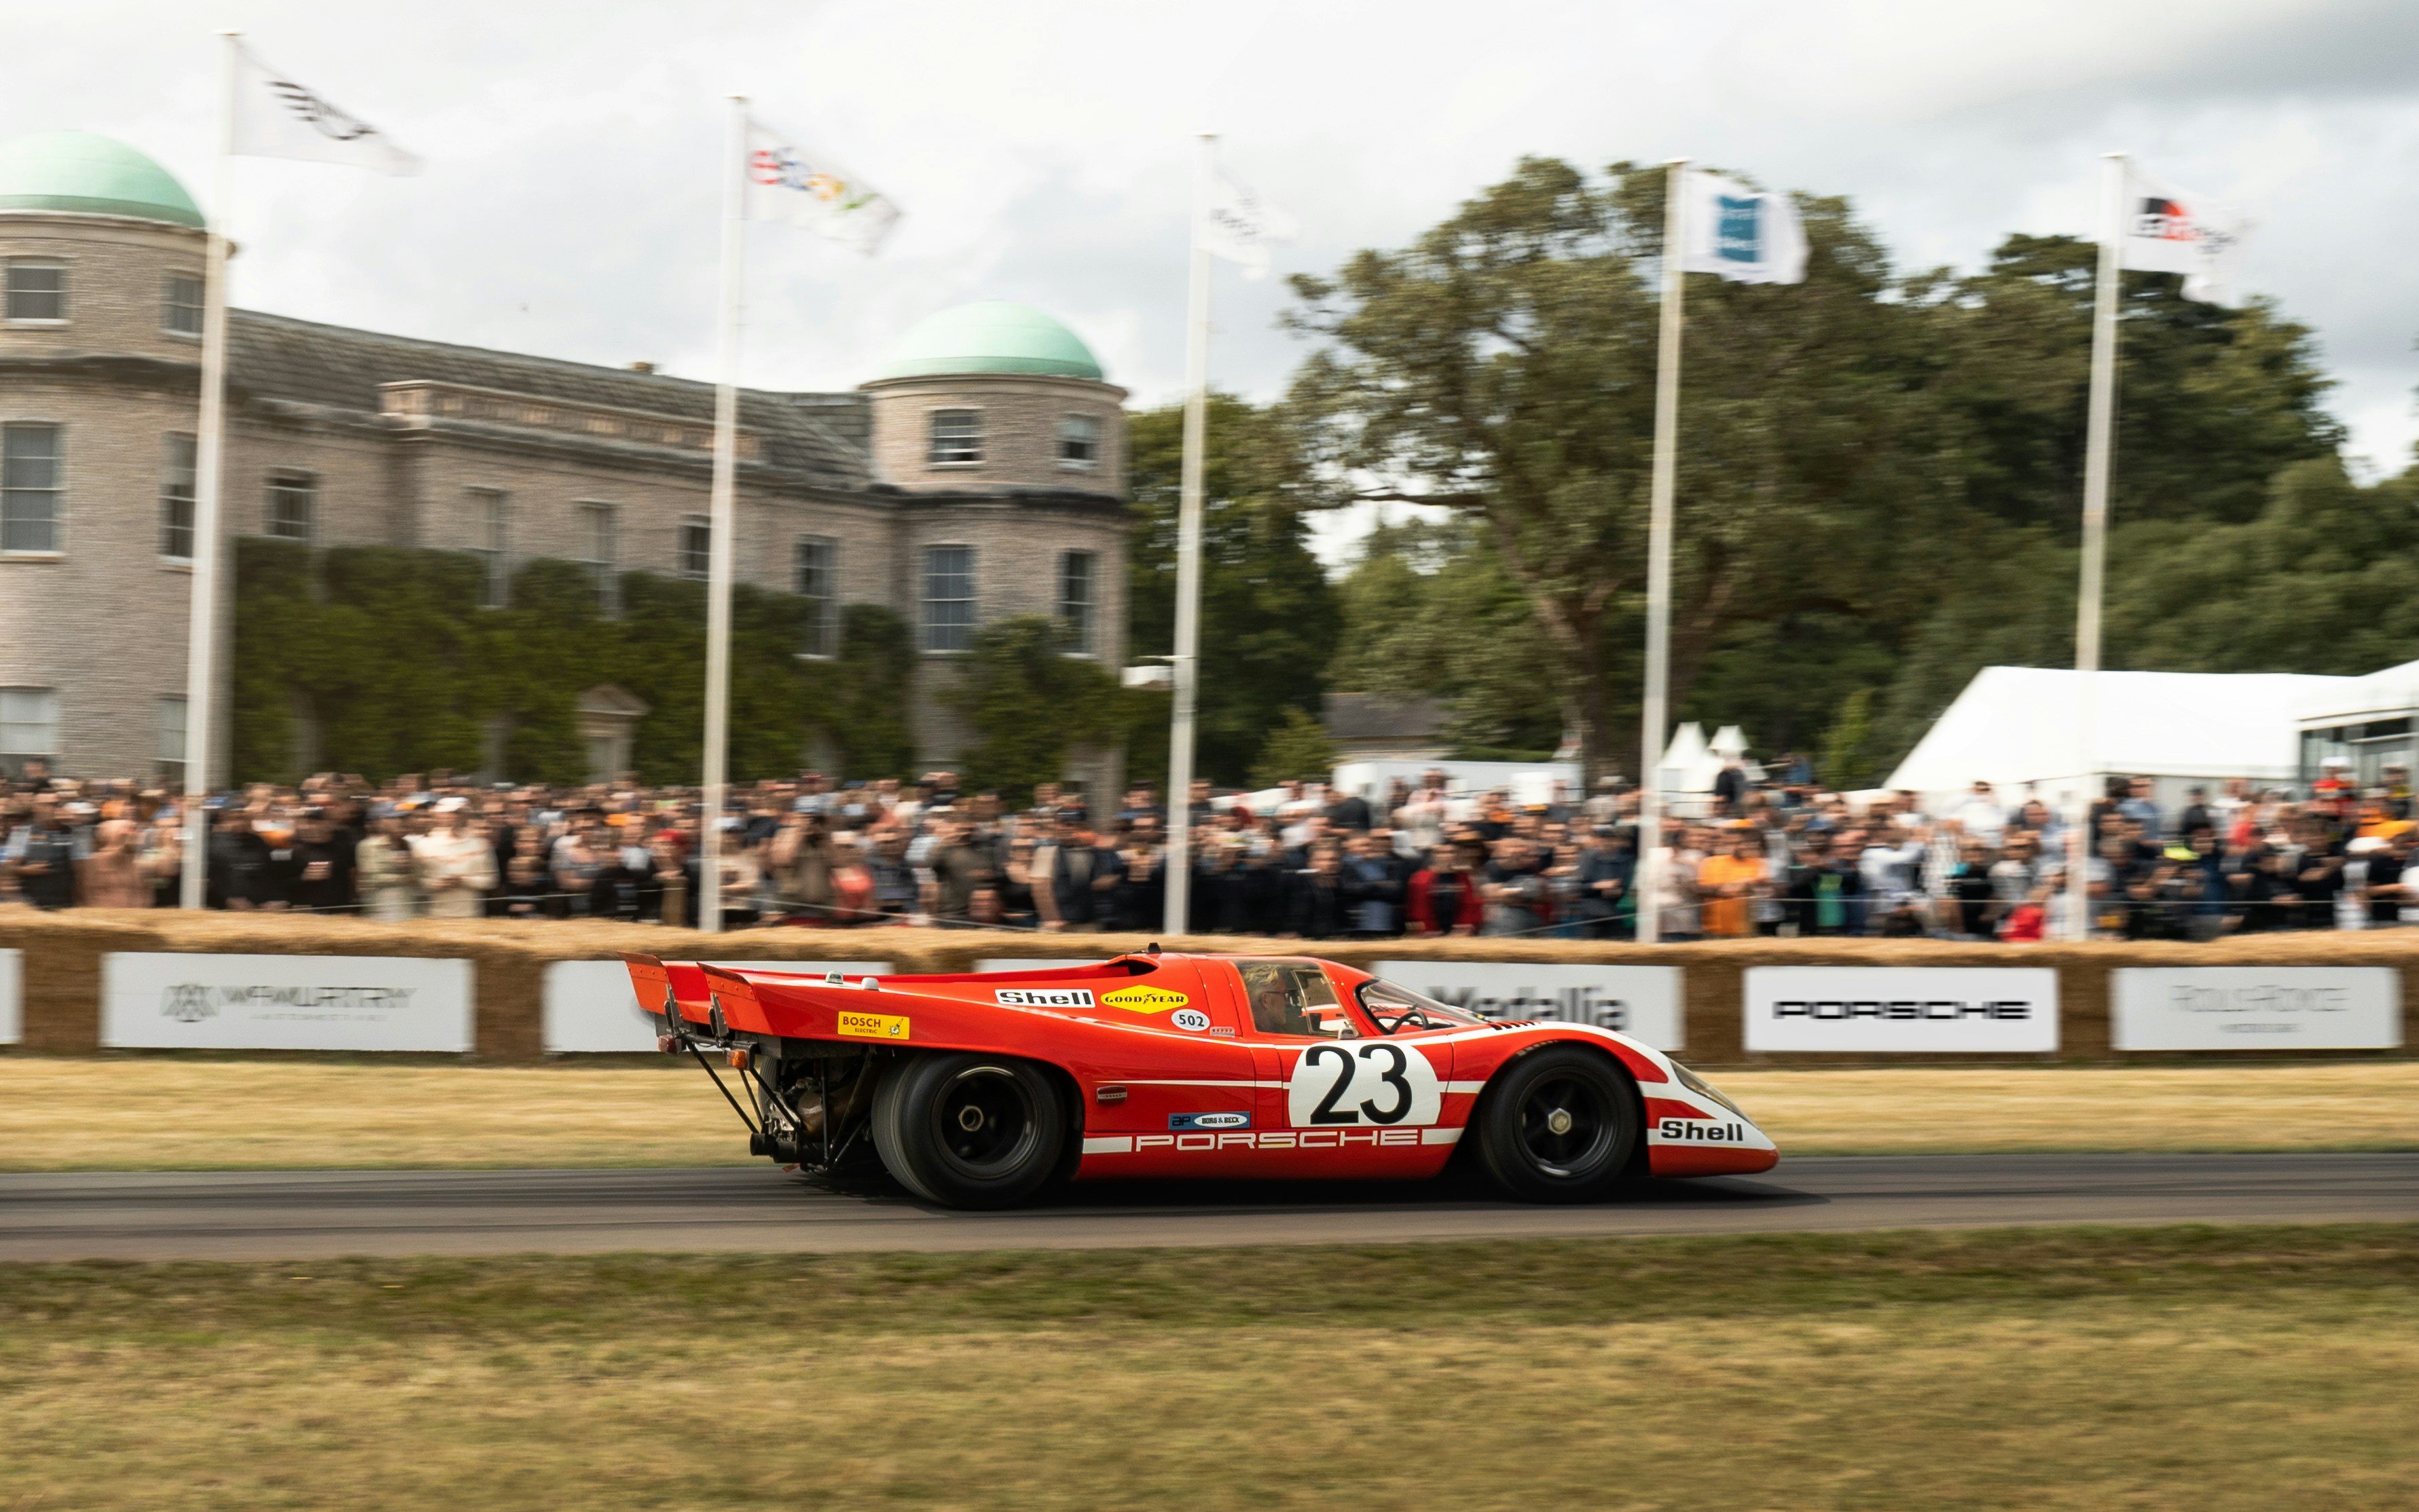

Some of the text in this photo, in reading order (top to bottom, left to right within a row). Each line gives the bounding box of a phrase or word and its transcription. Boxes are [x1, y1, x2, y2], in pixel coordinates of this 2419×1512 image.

[1000, 992, 1092, 1005] Shell
[1772, 1001, 2033, 1020] PORSCHE
[843, 1016, 881, 1027] BOSCH
[1179, 1014, 1205, 1027] 502
[1306, 1044, 1412, 1124] 23
[1135, 1129, 1419, 1152] PORSCHE
[1661, 1121, 1743, 1141] Shell
